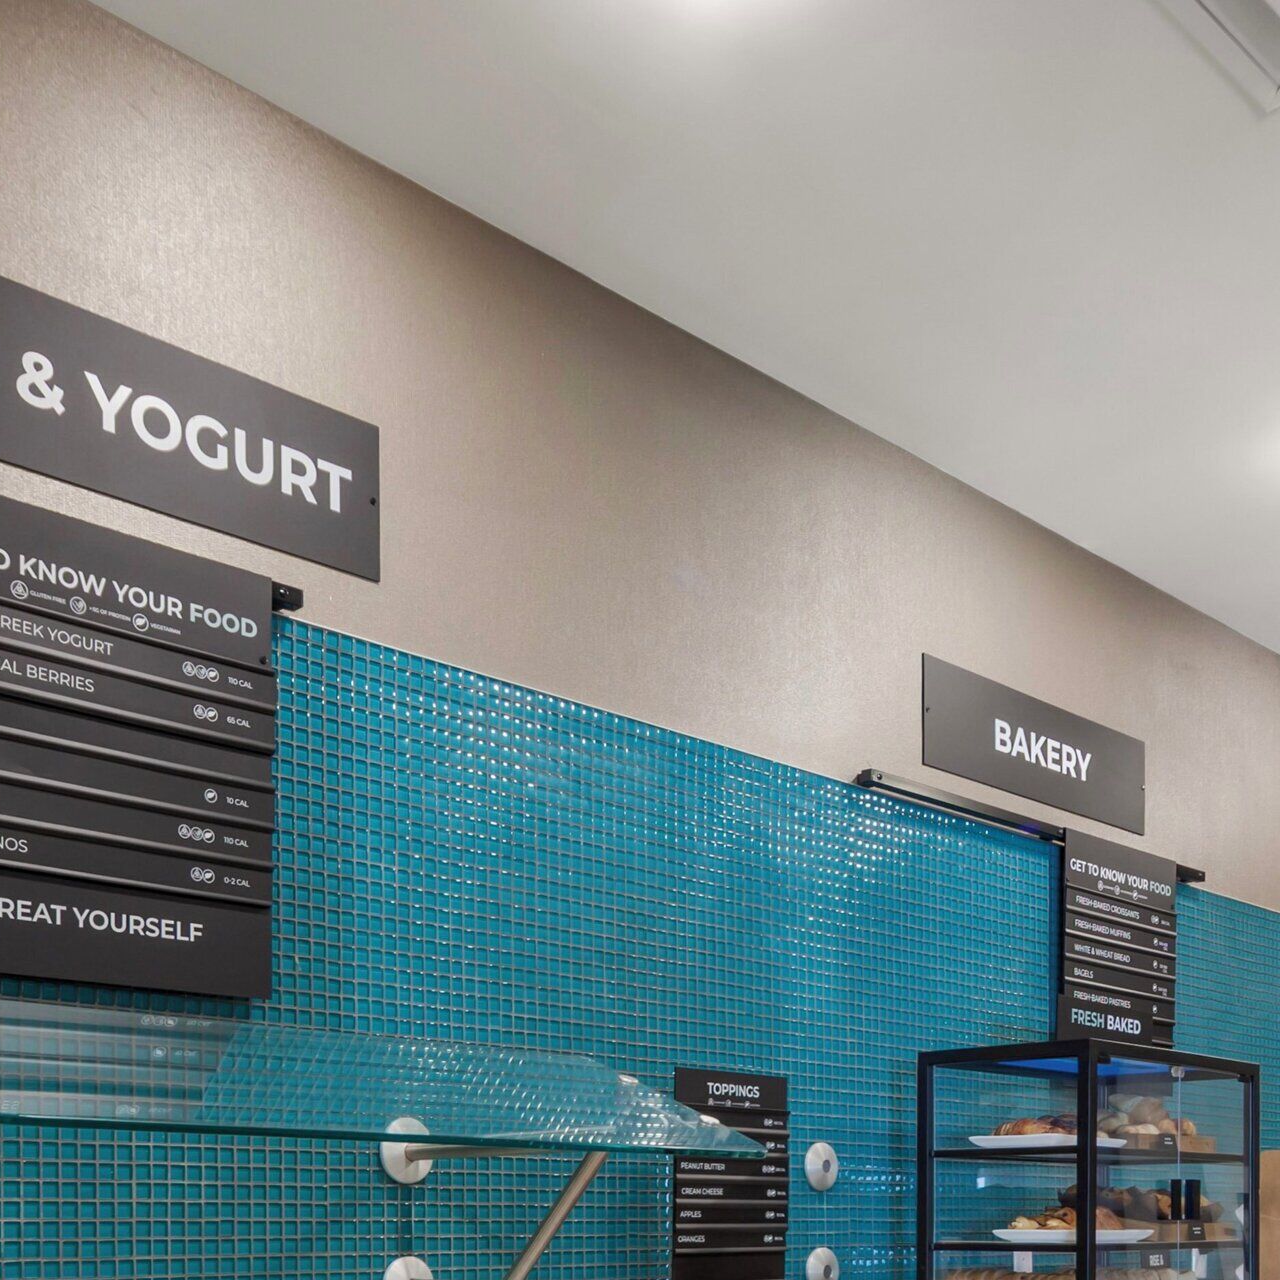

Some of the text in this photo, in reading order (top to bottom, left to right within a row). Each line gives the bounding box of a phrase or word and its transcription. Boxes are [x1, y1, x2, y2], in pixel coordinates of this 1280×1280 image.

[16, 351, 65, 416] &
[83, 370, 352, 513] YOGURT
[19, 555, 106, 597] KNOW
[112, 580, 182, 619] YOUR
[189, 604, 258, 639] FOOD
[48, 628, 113, 656] YOGURT
[26, 664, 95, 693] BERRIES
[227, 676, 253, 689] 110 CAL
[236, 719, 251, 728] CAL
[994, 718, 1092, 781] BAKERY
[235, 799, 249, 808] CAL
[234, 839, 248, 847] CAL
[224, 877, 250, 887] 0-2 CAL
[1070, 858, 1086, 873] GET
[1087, 863, 1099, 876] TO
[1100, 867, 1127, 884] KNOW
[1127, 874, 1148, 890] YOUR
[1149, 881, 1172, 896] FOOD
[72, 907, 204, 942] YOURSELF
[1114, 952, 1130, 963] BREAD
[1074, 967, 1093, 978] BAGELS
[1071, 1008, 1141, 1034] FRESH BAKED
[707, 1082, 760, 1098] TOPPINGS
[680, 1162, 725, 1171] PEANUT BUTTER
[681, 1187, 701, 1195] CREAM
[680, 1210, 701, 1218] APPLES
